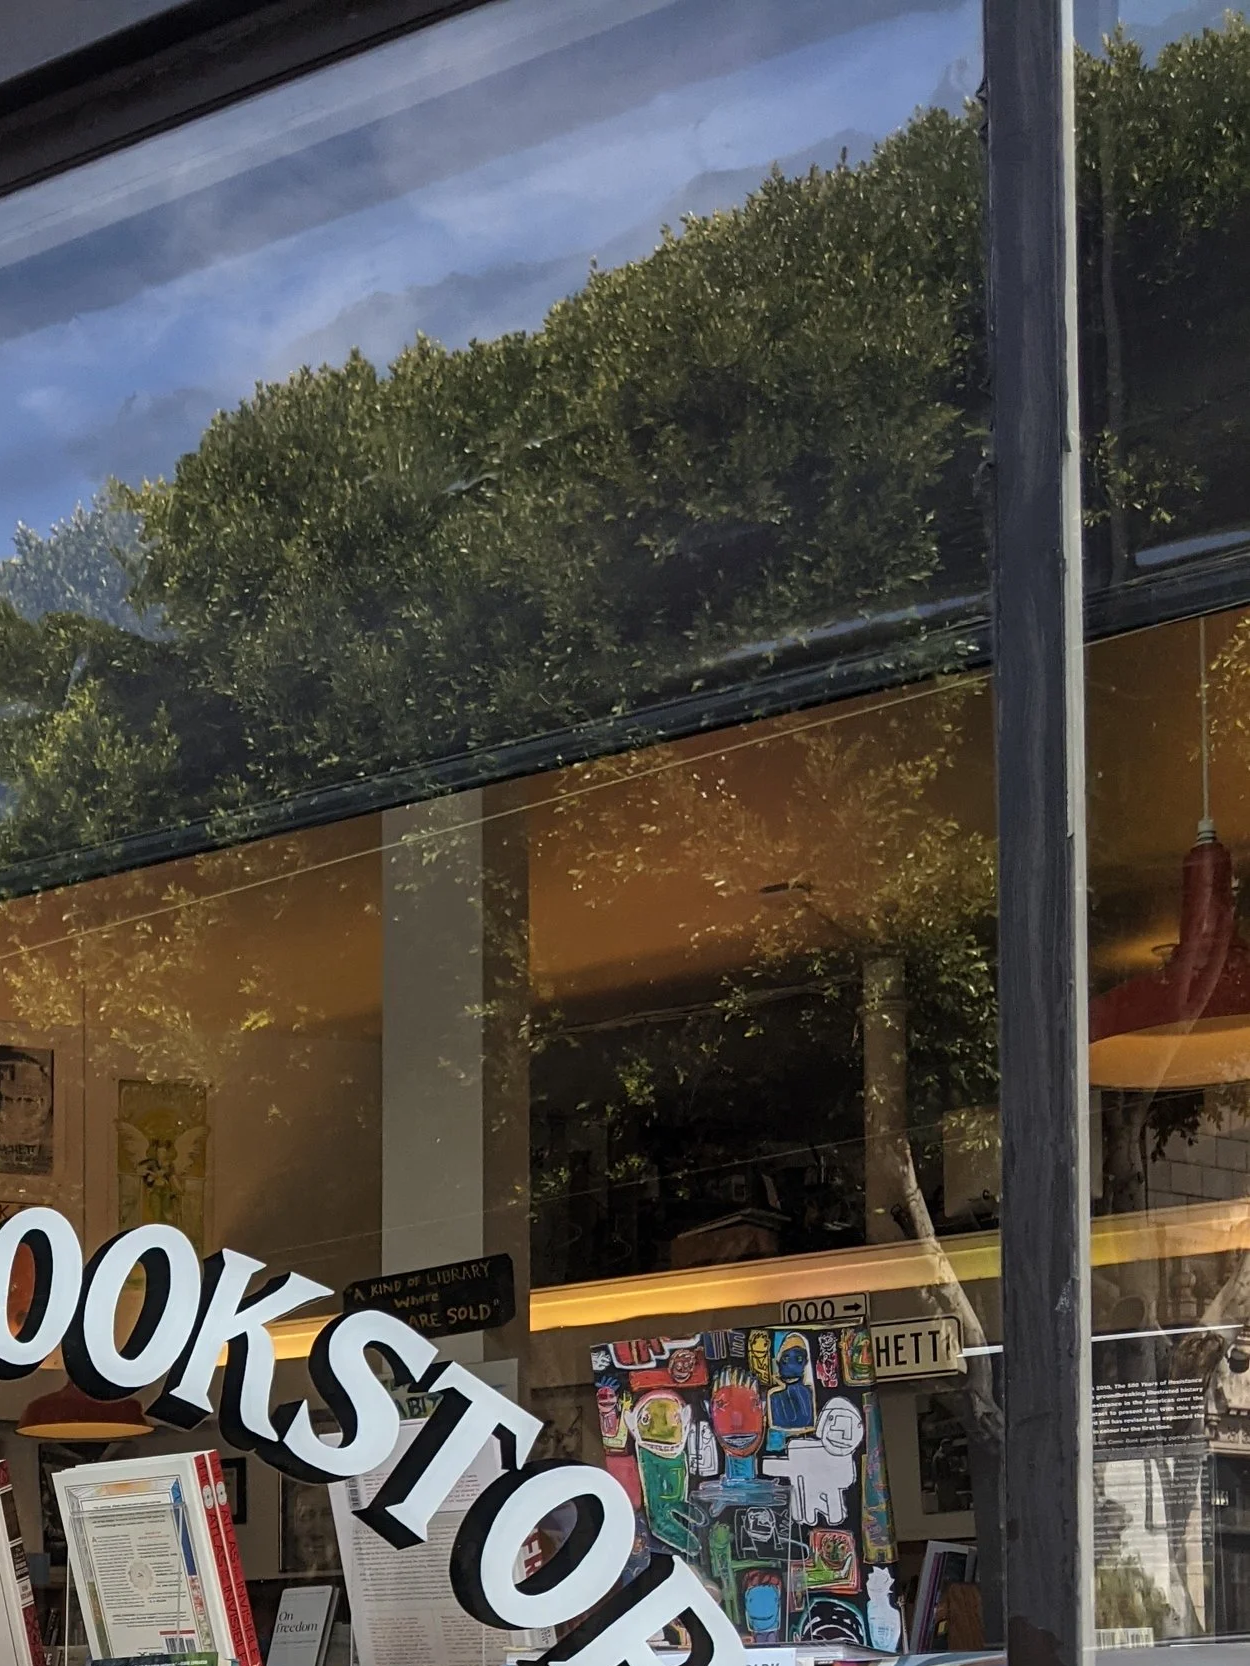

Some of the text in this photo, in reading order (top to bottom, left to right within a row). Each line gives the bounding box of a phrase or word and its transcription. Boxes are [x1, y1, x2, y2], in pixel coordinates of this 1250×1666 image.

[370, 1282, 400, 1297] KIND
[427, 1260, 491, 1285] LIBRARY
[394, 1292, 439, 1308] Where
[408, 1313, 441, 1328] ARE
[276, 1622, 318, 1633] Freedom
